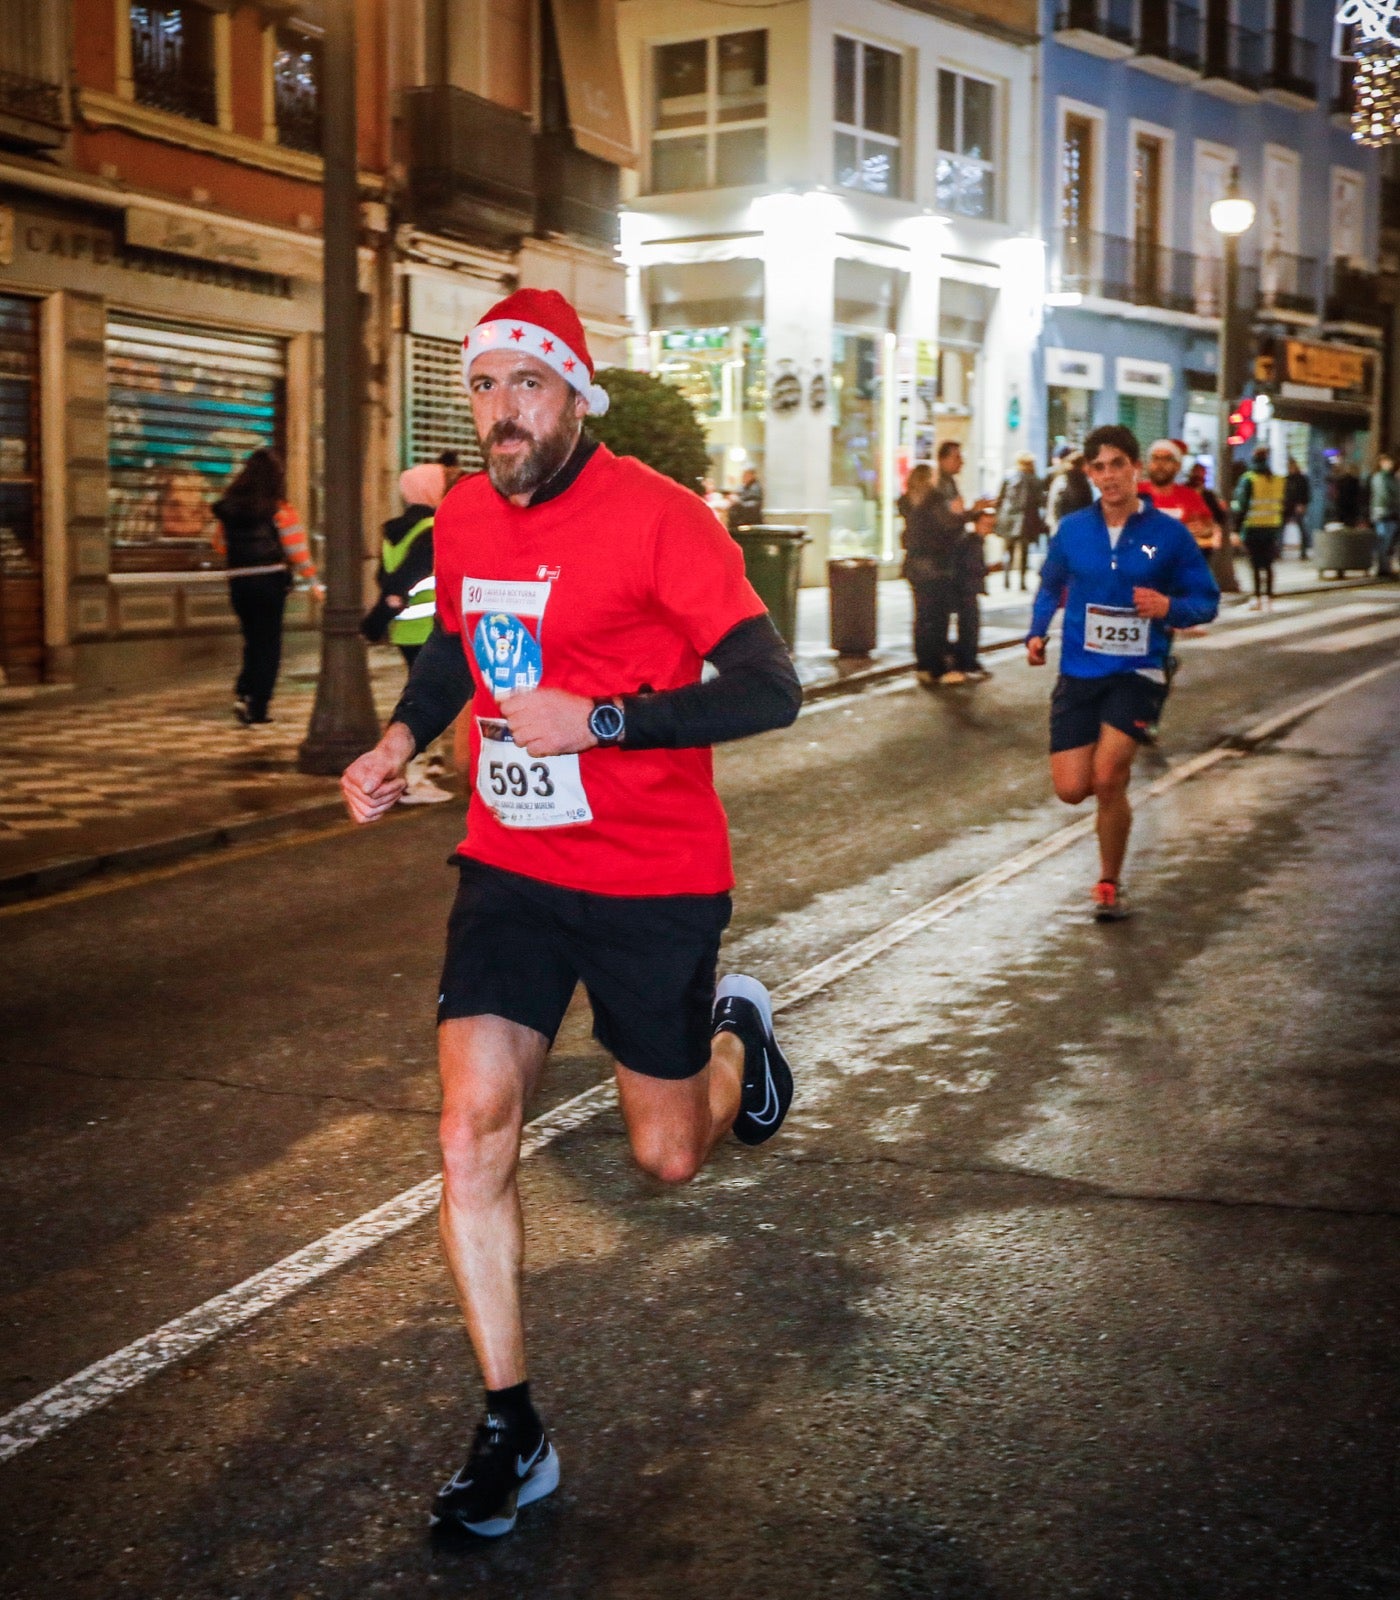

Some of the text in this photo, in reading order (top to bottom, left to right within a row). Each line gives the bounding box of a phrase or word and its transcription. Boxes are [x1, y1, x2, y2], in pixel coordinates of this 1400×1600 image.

[468, 586, 482, 603] 30
[1095, 625, 1140, 642] 1253
[489, 761, 555, 797] 593
